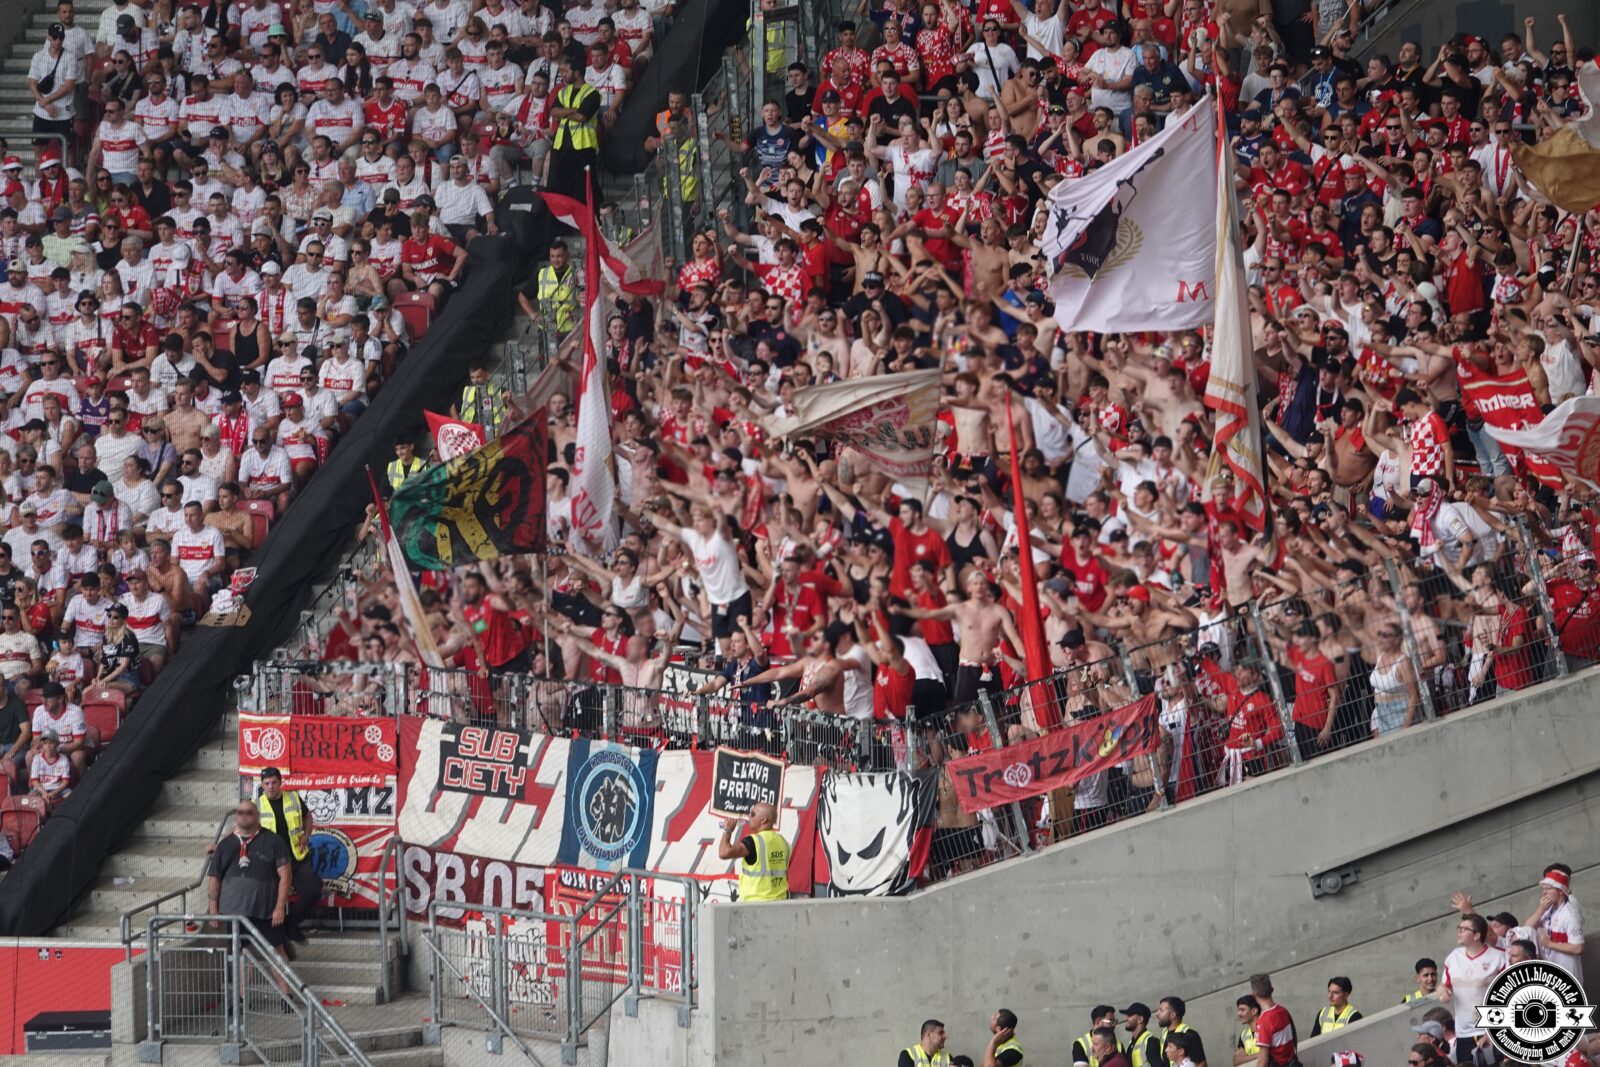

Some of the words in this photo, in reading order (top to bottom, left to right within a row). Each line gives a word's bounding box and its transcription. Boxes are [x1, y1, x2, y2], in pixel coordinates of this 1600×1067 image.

[458, 726, 520, 762] SUB
[315, 776, 335, 786] will
[337, 775, 347, 785] be
[350, 774, 381, 785] friends
[443, 756, 526, 796] CIETY
[732, 761, 770, 784] CURVA
[343, 787, 395, 817] MZ
[719, 779, 775, 805] PARADISO
[770, 850, 784, 859] SDS
